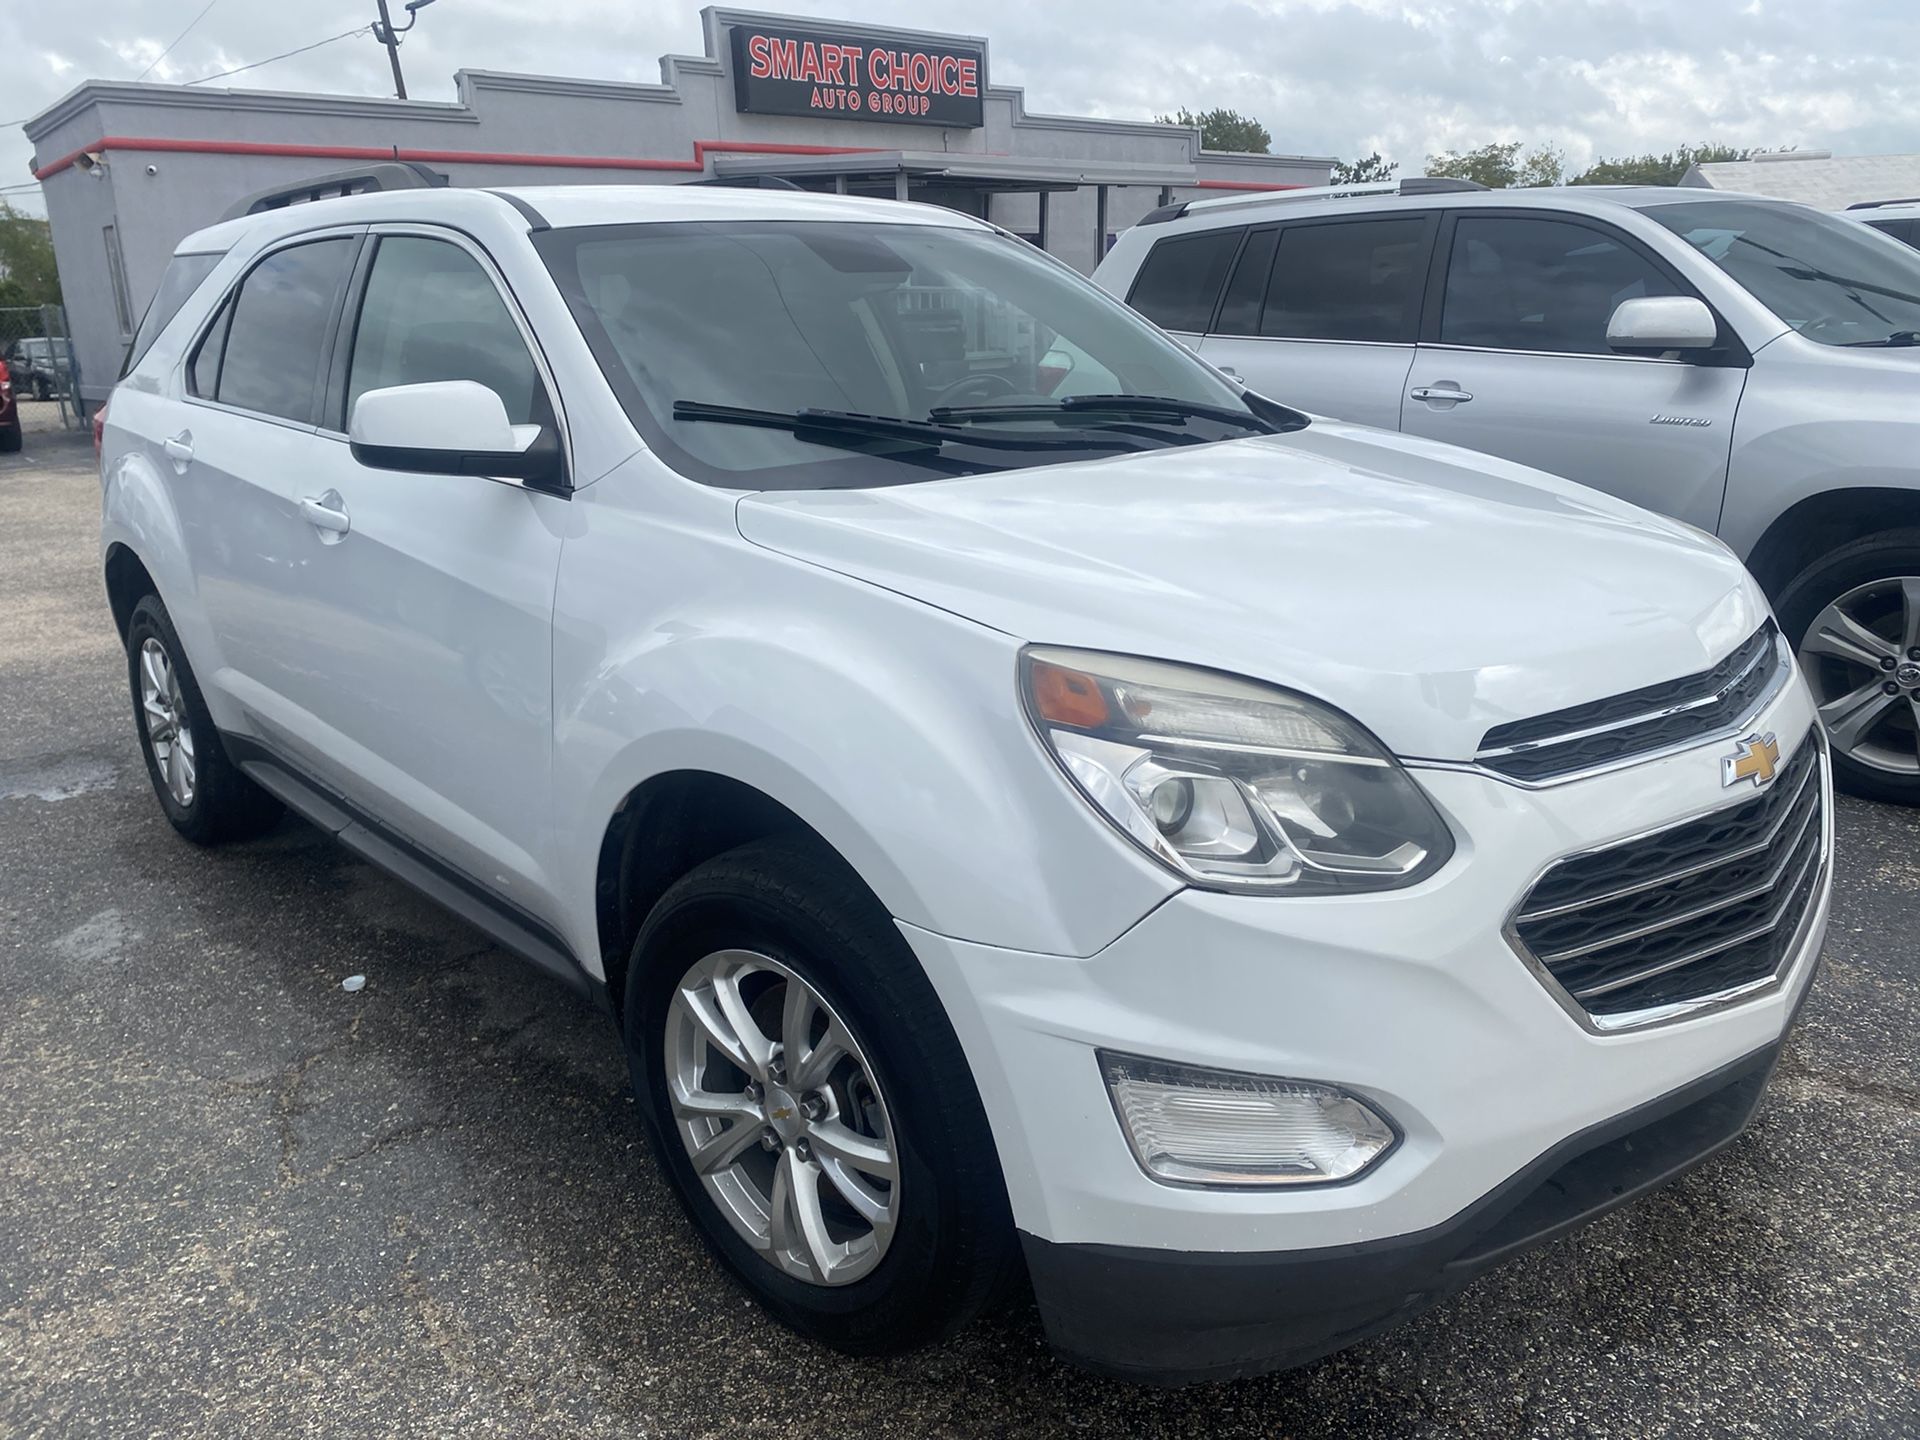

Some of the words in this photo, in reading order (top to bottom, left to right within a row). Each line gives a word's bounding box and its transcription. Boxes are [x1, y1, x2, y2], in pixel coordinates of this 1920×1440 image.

[749, 35, 862, 87] SMART
[868, 48, 978, 98] CHOICE
[810, 87, 861, 111] AUTO
[868, 91, 930, 116] GROUP
